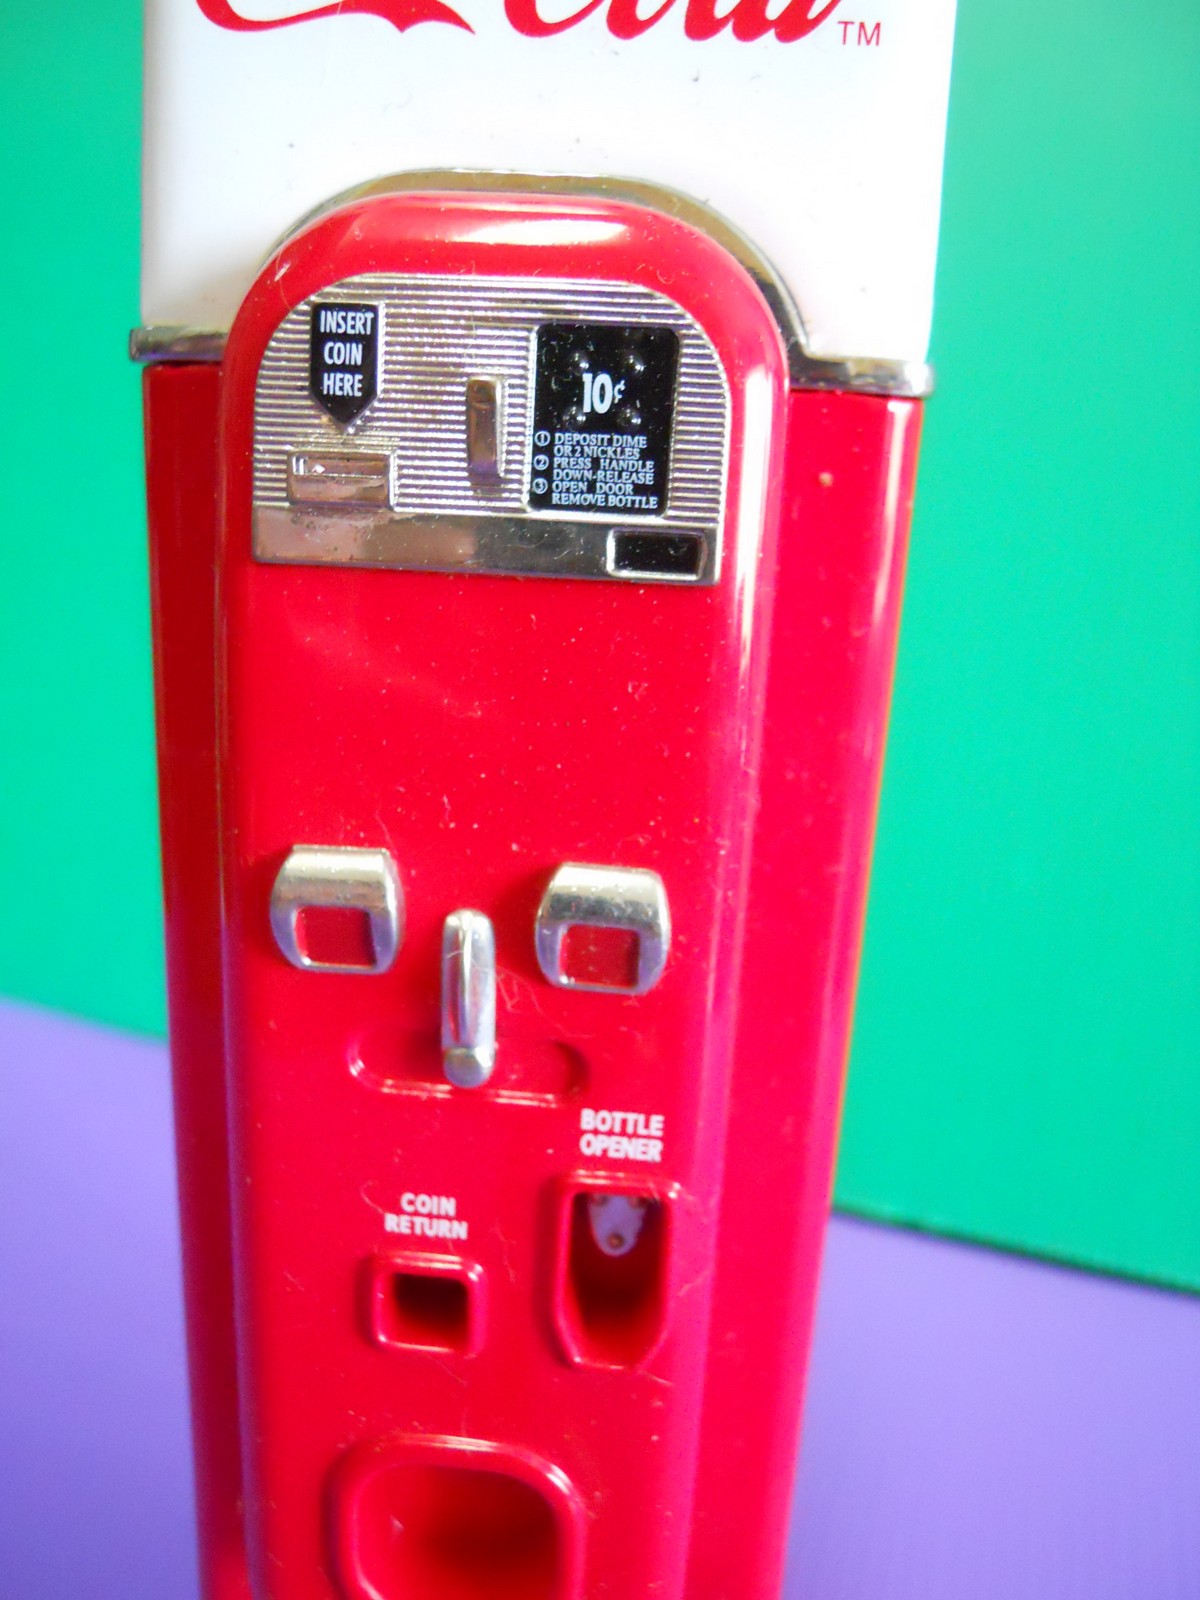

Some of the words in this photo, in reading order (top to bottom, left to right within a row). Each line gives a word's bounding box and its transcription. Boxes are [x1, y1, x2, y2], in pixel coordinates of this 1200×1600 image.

[838, 20, 881, 47] TM
[320, 310, 375, 335] INSERT
[324, 341, 363, 365] COIN
[323, 372, 363, 397] HERE
[553, 445, 573, 457] OR
[574, 446, 581, 457] 2
[583, 446, 640, 460] NICKLES
[554, 433, 611, 447] DEPOSIT
[612, 435, 647, 448] DIME
[553, 457, 592, 470] PRESS
[600, 459, 655, 472] HANDLE
[552, 481, 588, 493] OPEN
[596, 482, 634, 495] DOOR
[551, 493, 606, 506] REMOVE
[607, 495, 658, 509] BOTTLE
[580, 1108, 664, 1137] BOTTLE
[579, 1133, 663, 1162] OPENER
[400, 1192, 456, 1216] COIN
[384, 1213, 468, 1240] RETURN
